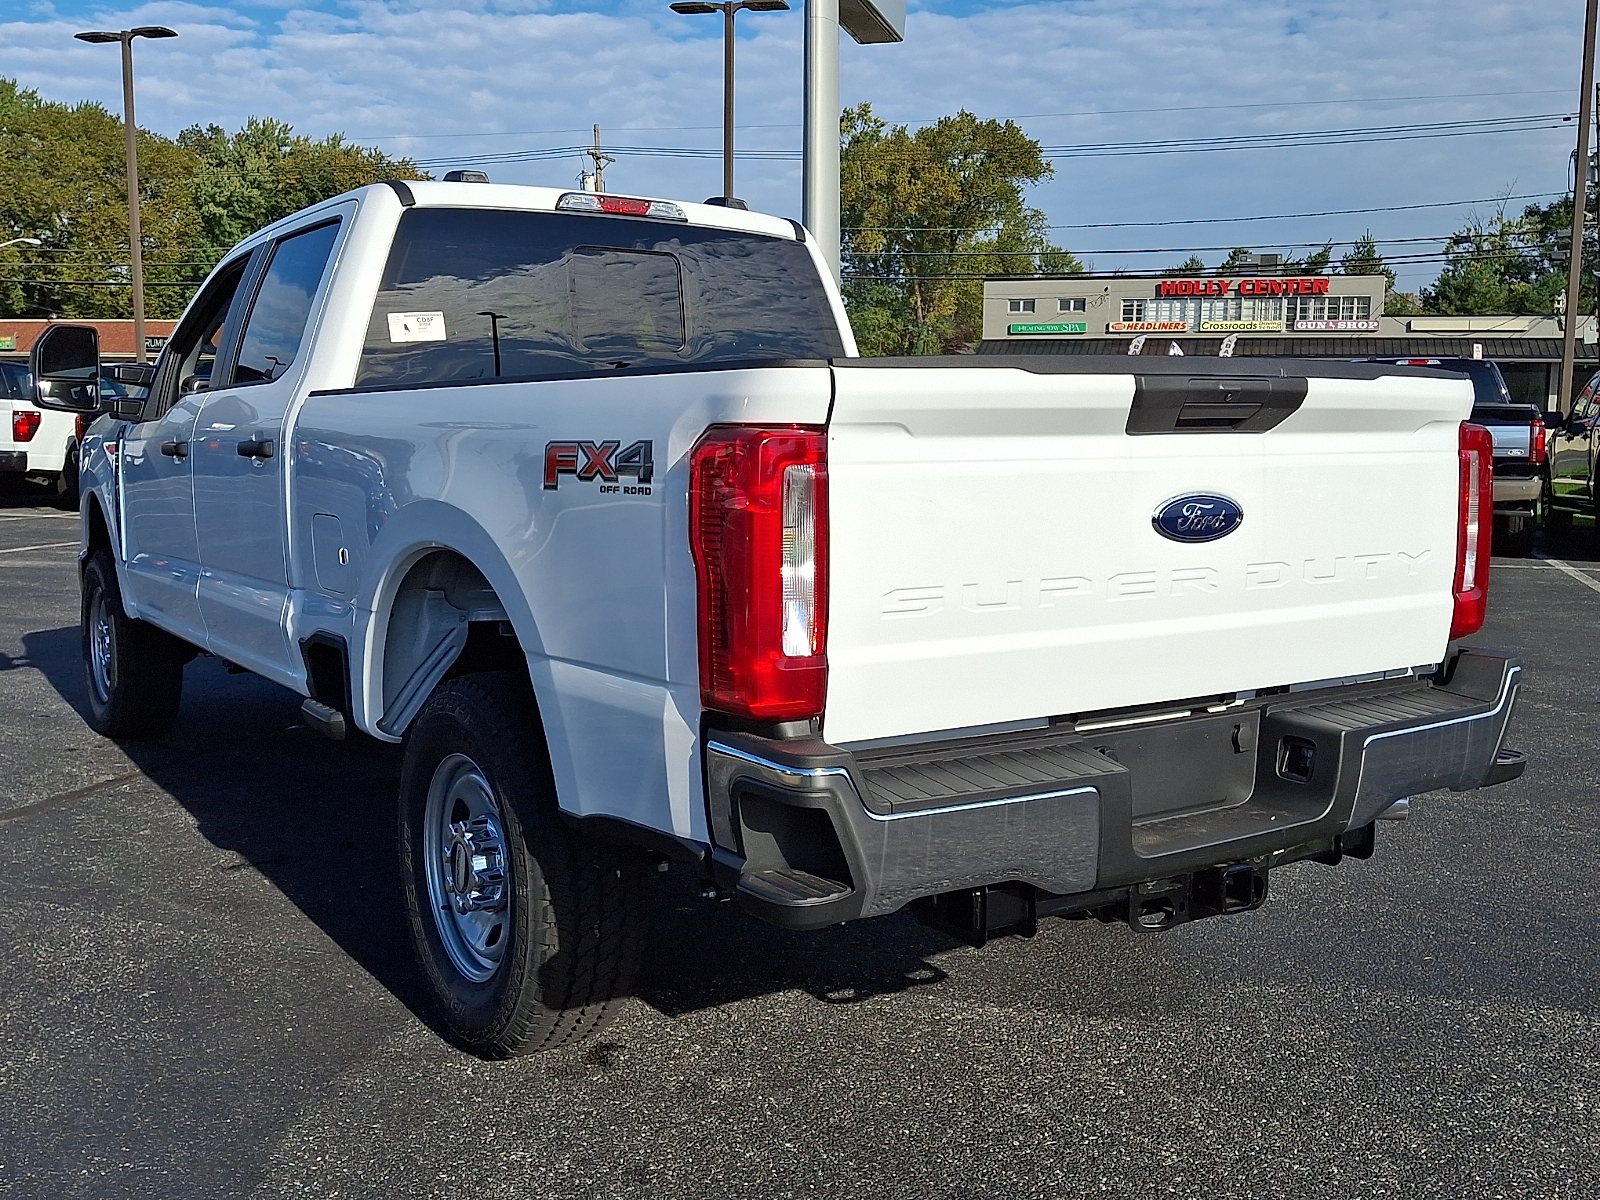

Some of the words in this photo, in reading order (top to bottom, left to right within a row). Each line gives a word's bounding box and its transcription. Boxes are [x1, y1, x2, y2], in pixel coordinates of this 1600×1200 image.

[1160, 279, 1233, 295] HOLLY
[1240, 278, 1330, 295] CENTER
[1061, 323, 1080, 332] SPA
[1126, 322, 1187, 331] HEADLINERS
[1201, 321, 1258, 330] Crossroads
[1297, 321, 1327, 329] GUN
[1337, 321, 1379, 329] SHOP
[543, 439, 654, 491] FX4
[600, 485, 620, 494] OFF
[623, 486, 652, 496] ROAD
[1177, 502, 1226, 532] Ford
[881, 566, 1219, 620] SUPER
[1245, 549, 1432, 592] DUTY
